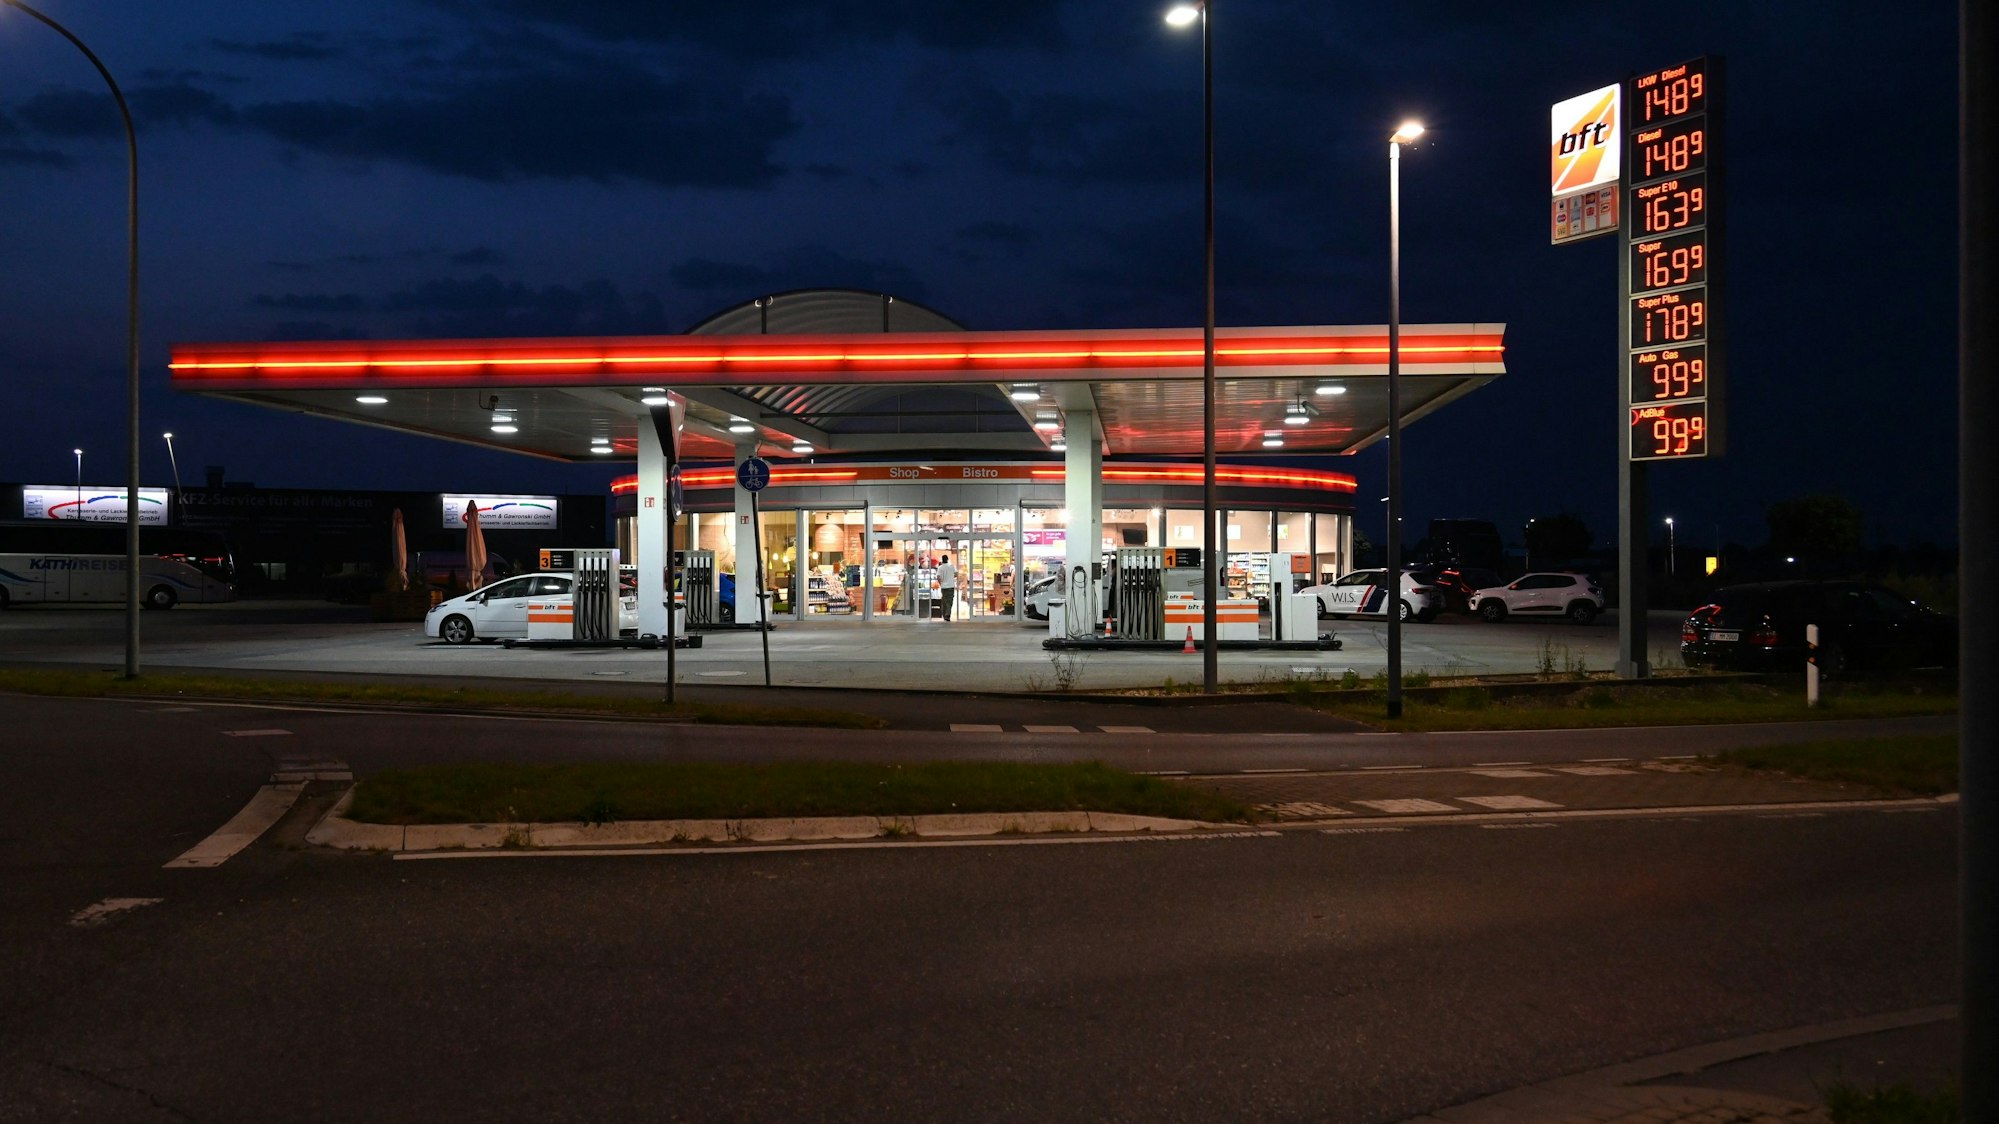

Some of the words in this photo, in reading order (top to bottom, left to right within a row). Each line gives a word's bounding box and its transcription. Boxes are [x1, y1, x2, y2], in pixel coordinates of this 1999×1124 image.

[1638, 74, 1657, 89] LKW
[1661, 65, 1686, 81] Diesel
[1559, 122, 1608, 156] bft
[1638, 128, 1662, 144] Diesel
[1638, 185, 1661, 199] Super
[1661, 180, 1678, 193] E10
[1638, 241, 1662, 253] Super
[1638, 296, 1661, 309] Super
[1662, 294, 1679, 304] Plus
[1639, 353, 1657, 363] Auto
[1662, 350, 1679, 360] Gas
[1639, 408, 1665, 419] AdBlue
[889, 467, 920, 479] Shop
[963, 467, 998, 478] Bistro
[178, 492, 266, 506] KFZ-Service
[320, 495, 374, 507] Marken
[541, 557, 549, 568] 3
[1166, 555, 1173, 566] 1
[1331, 592, 1356, 603] W.I.S.
